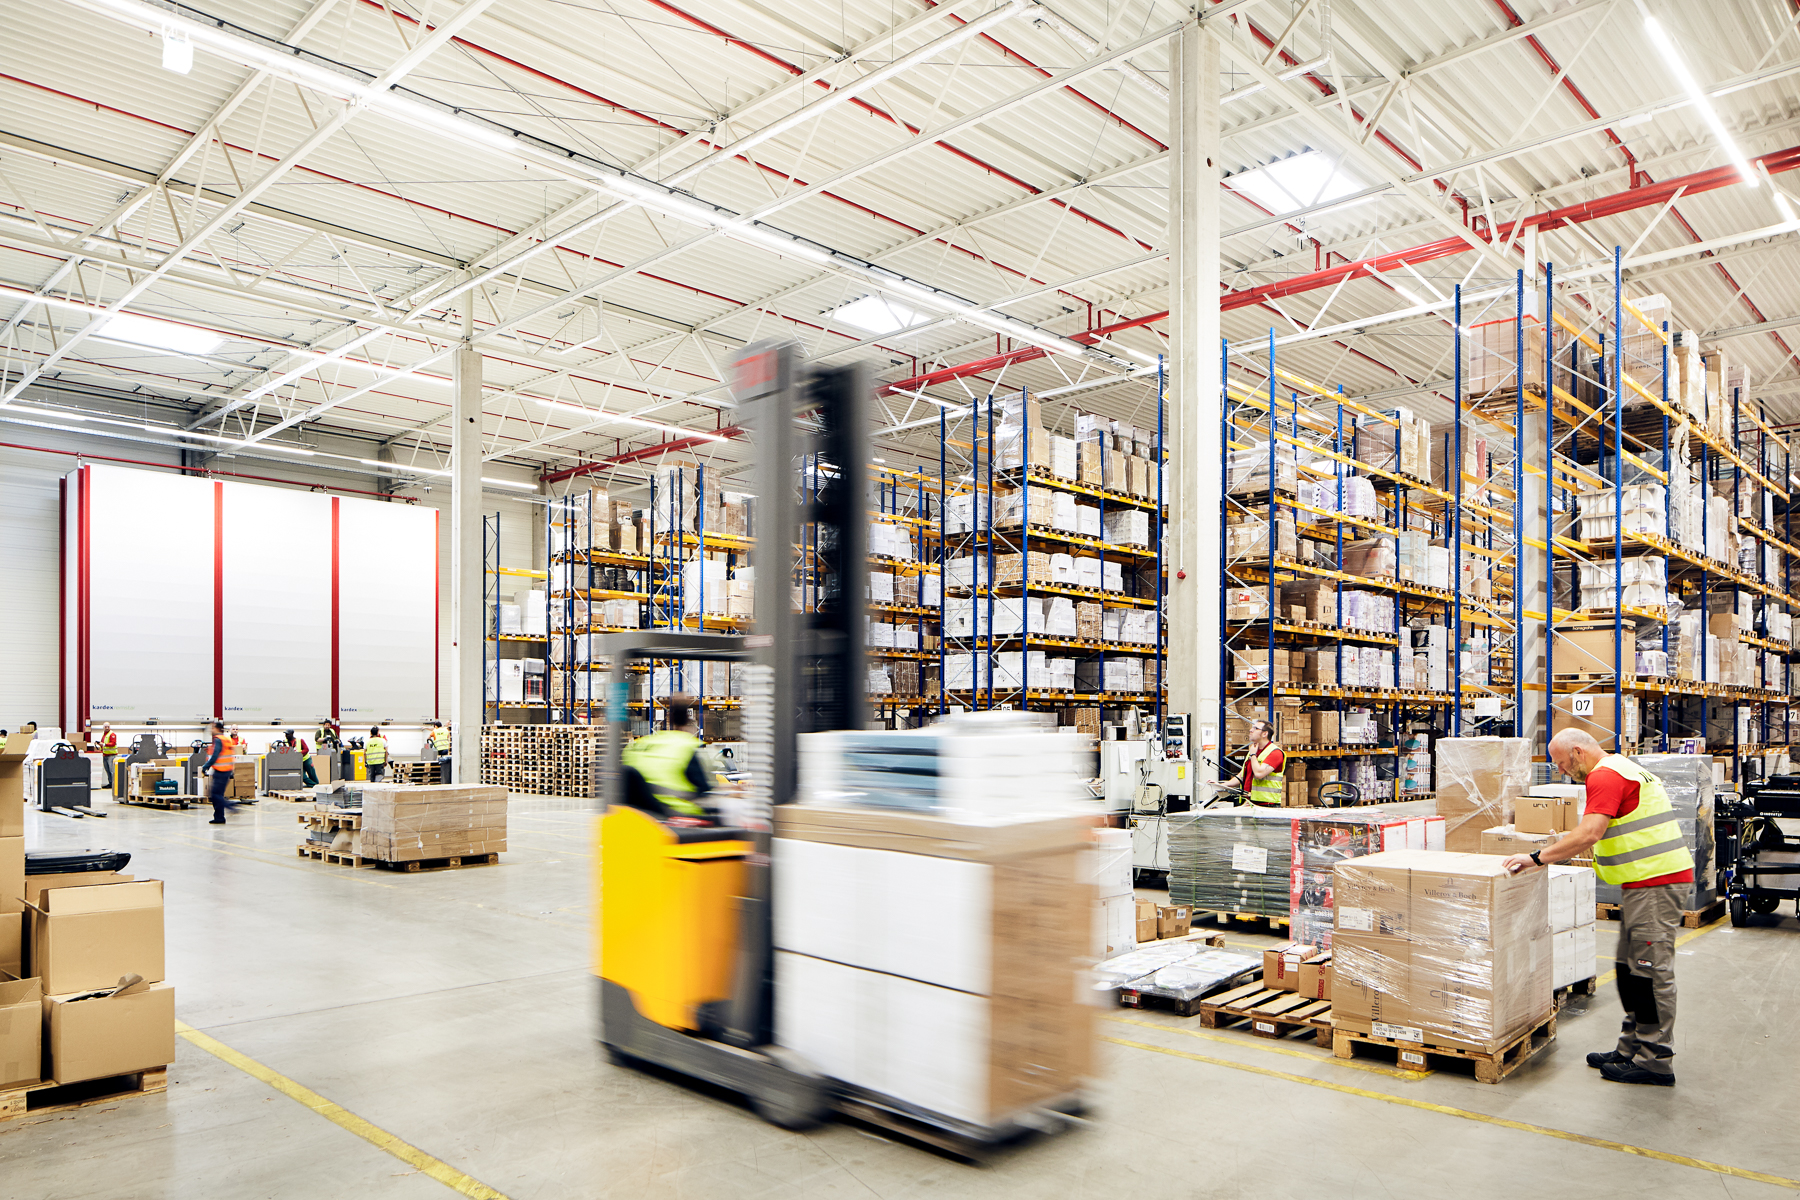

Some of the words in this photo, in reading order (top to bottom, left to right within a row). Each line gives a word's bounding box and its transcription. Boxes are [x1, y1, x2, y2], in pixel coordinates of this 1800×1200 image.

[1575, 699, 1591, 711] 07
[279, 746, 291, 755] 37
[60, 751, 75, 760] 33
[1424, 889, 1451, 898] Villeroy
[1371, 985, 1380, 1021] Villero
